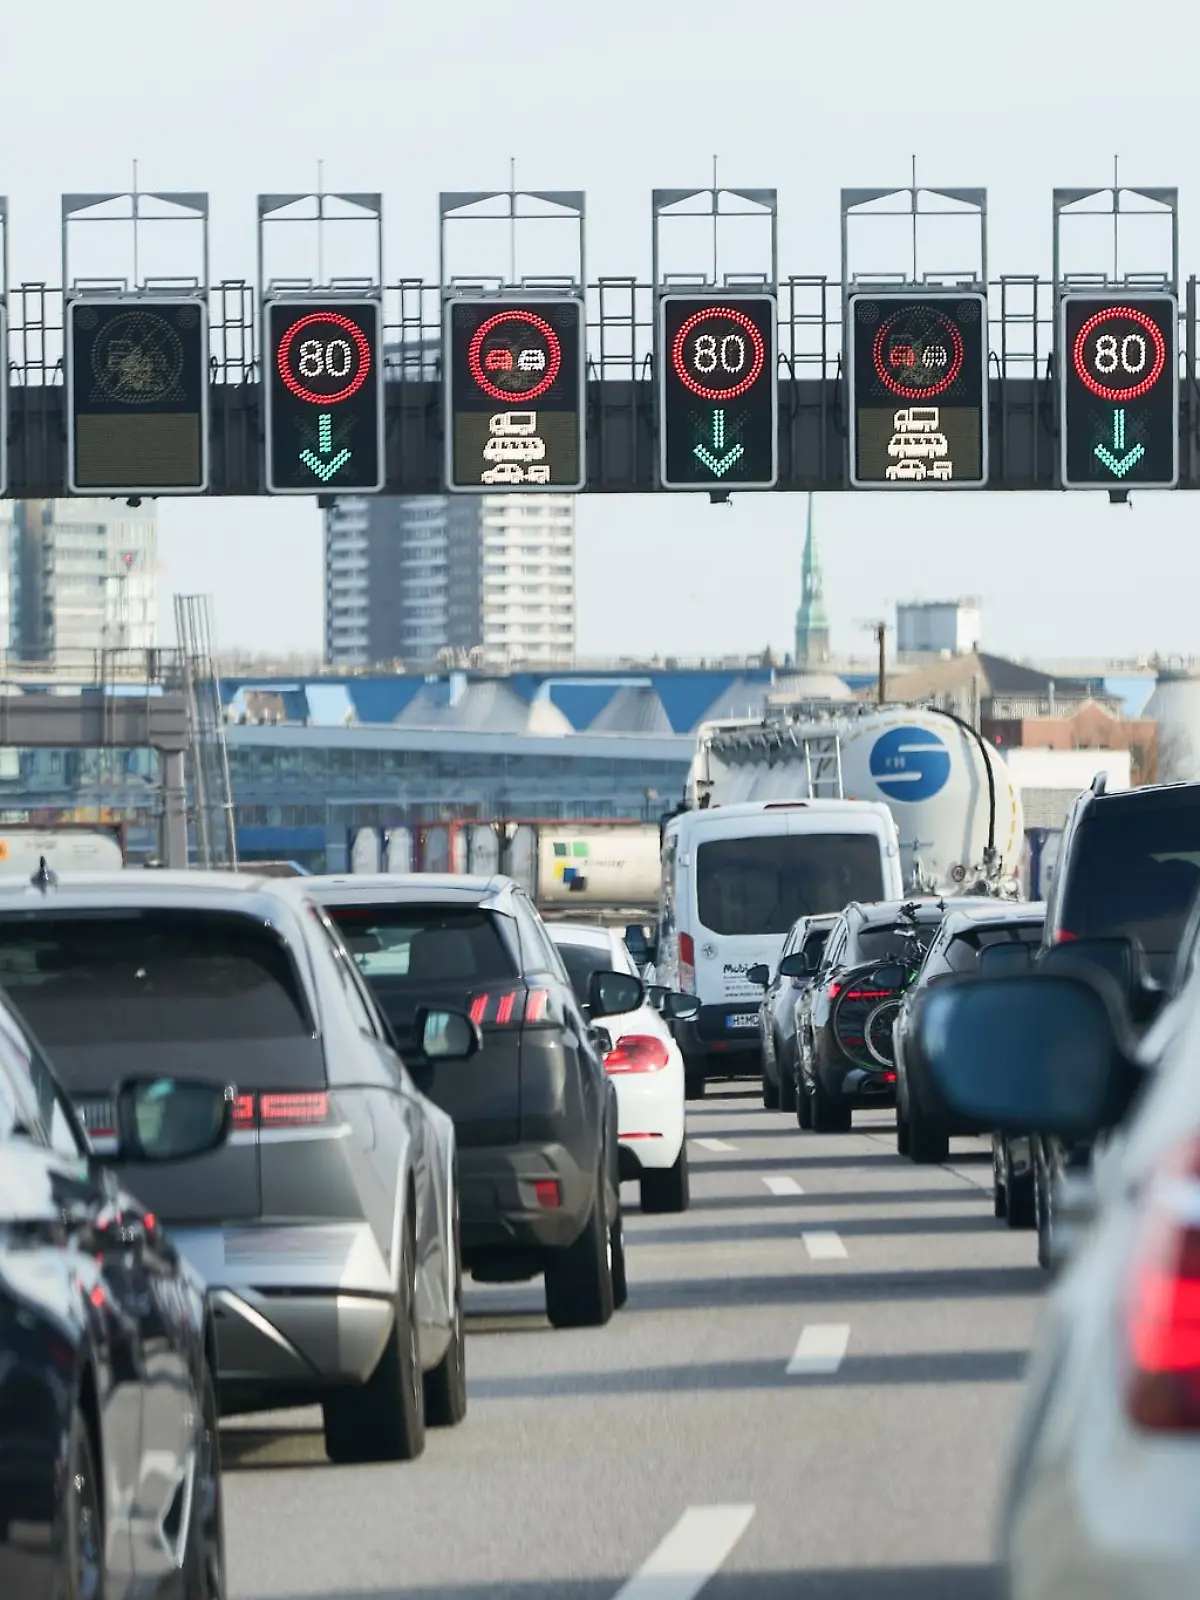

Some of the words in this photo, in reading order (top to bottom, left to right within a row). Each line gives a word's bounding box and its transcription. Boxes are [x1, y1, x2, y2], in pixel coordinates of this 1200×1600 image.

[298, 339, 352, 378] 80
[693, 334, 745, 374] 80
[1094, 334, 1147, 374] 80
